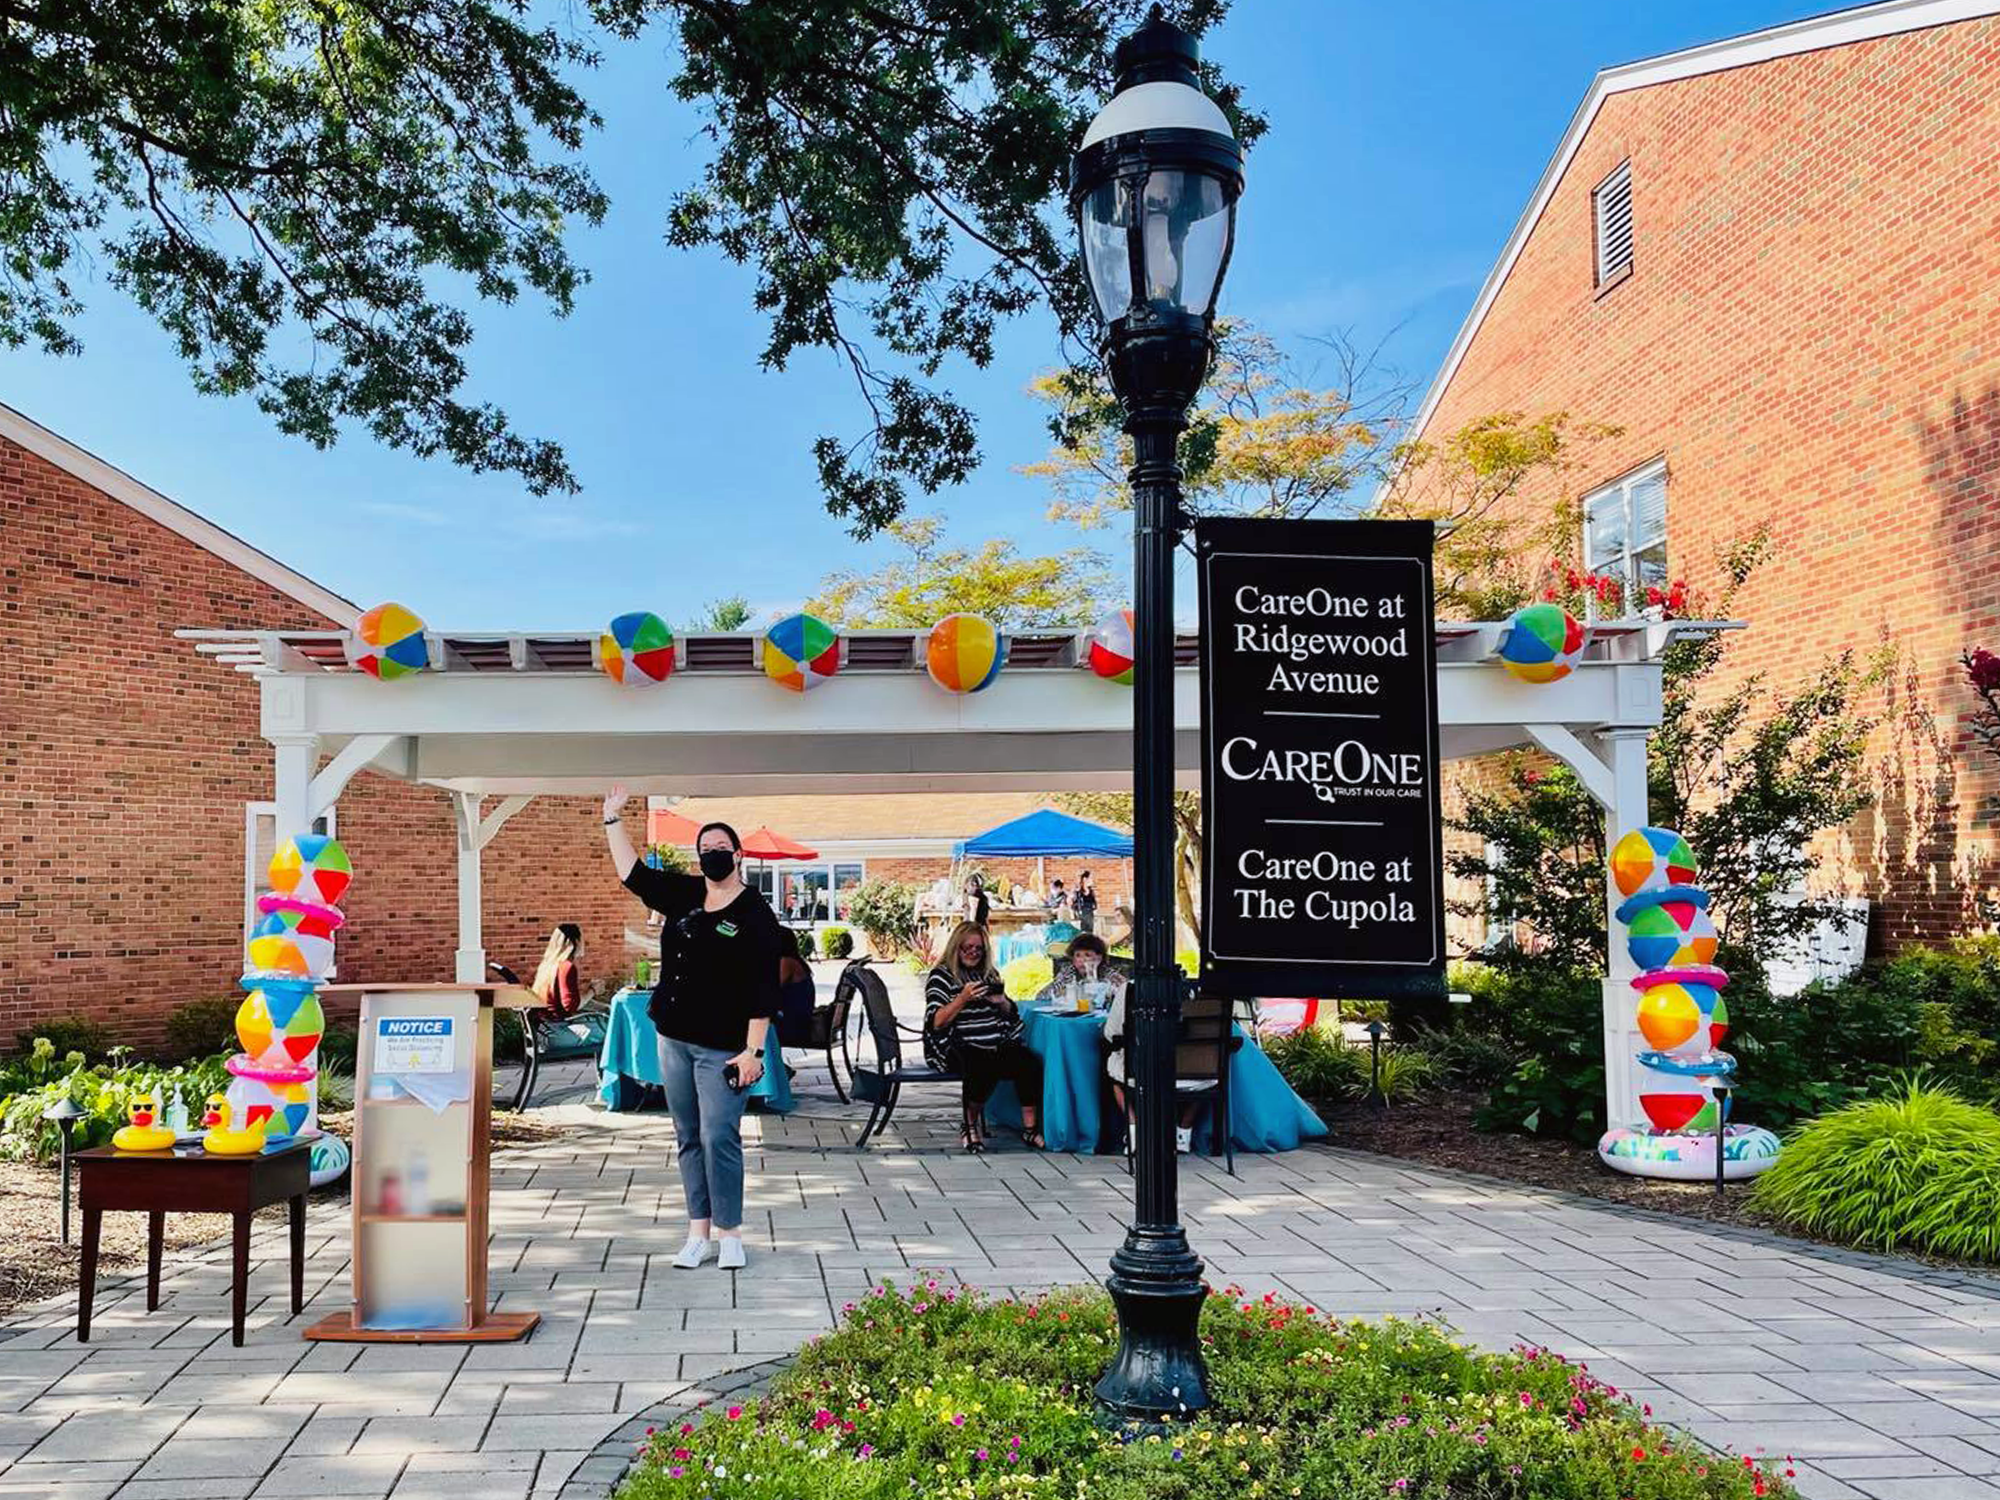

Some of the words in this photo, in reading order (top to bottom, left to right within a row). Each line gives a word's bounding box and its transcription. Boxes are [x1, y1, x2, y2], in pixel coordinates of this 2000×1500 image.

[1235, 586, 1369, 618] CareOne
[1378, 594, 1406, 619] at
[1234, 623, 1408, 662] Ridgewood
[1266, 663, 1379, 695] Avenue
[1333, 787, 1362, 796] TRUST
[1364, 788, 1374, 796] IN
[1375, 788, 1395, 797] OUR
[1396, 788, 1422, 798] CARE
[1238, 849, 1376, 882] CareOne
[1385, 857, 1413, 883] at
[1233, 889, 1295, 920] The
[1305, 890, 1416, 929] Cupola
[388, 1021, 444, 1034] NOTICE
